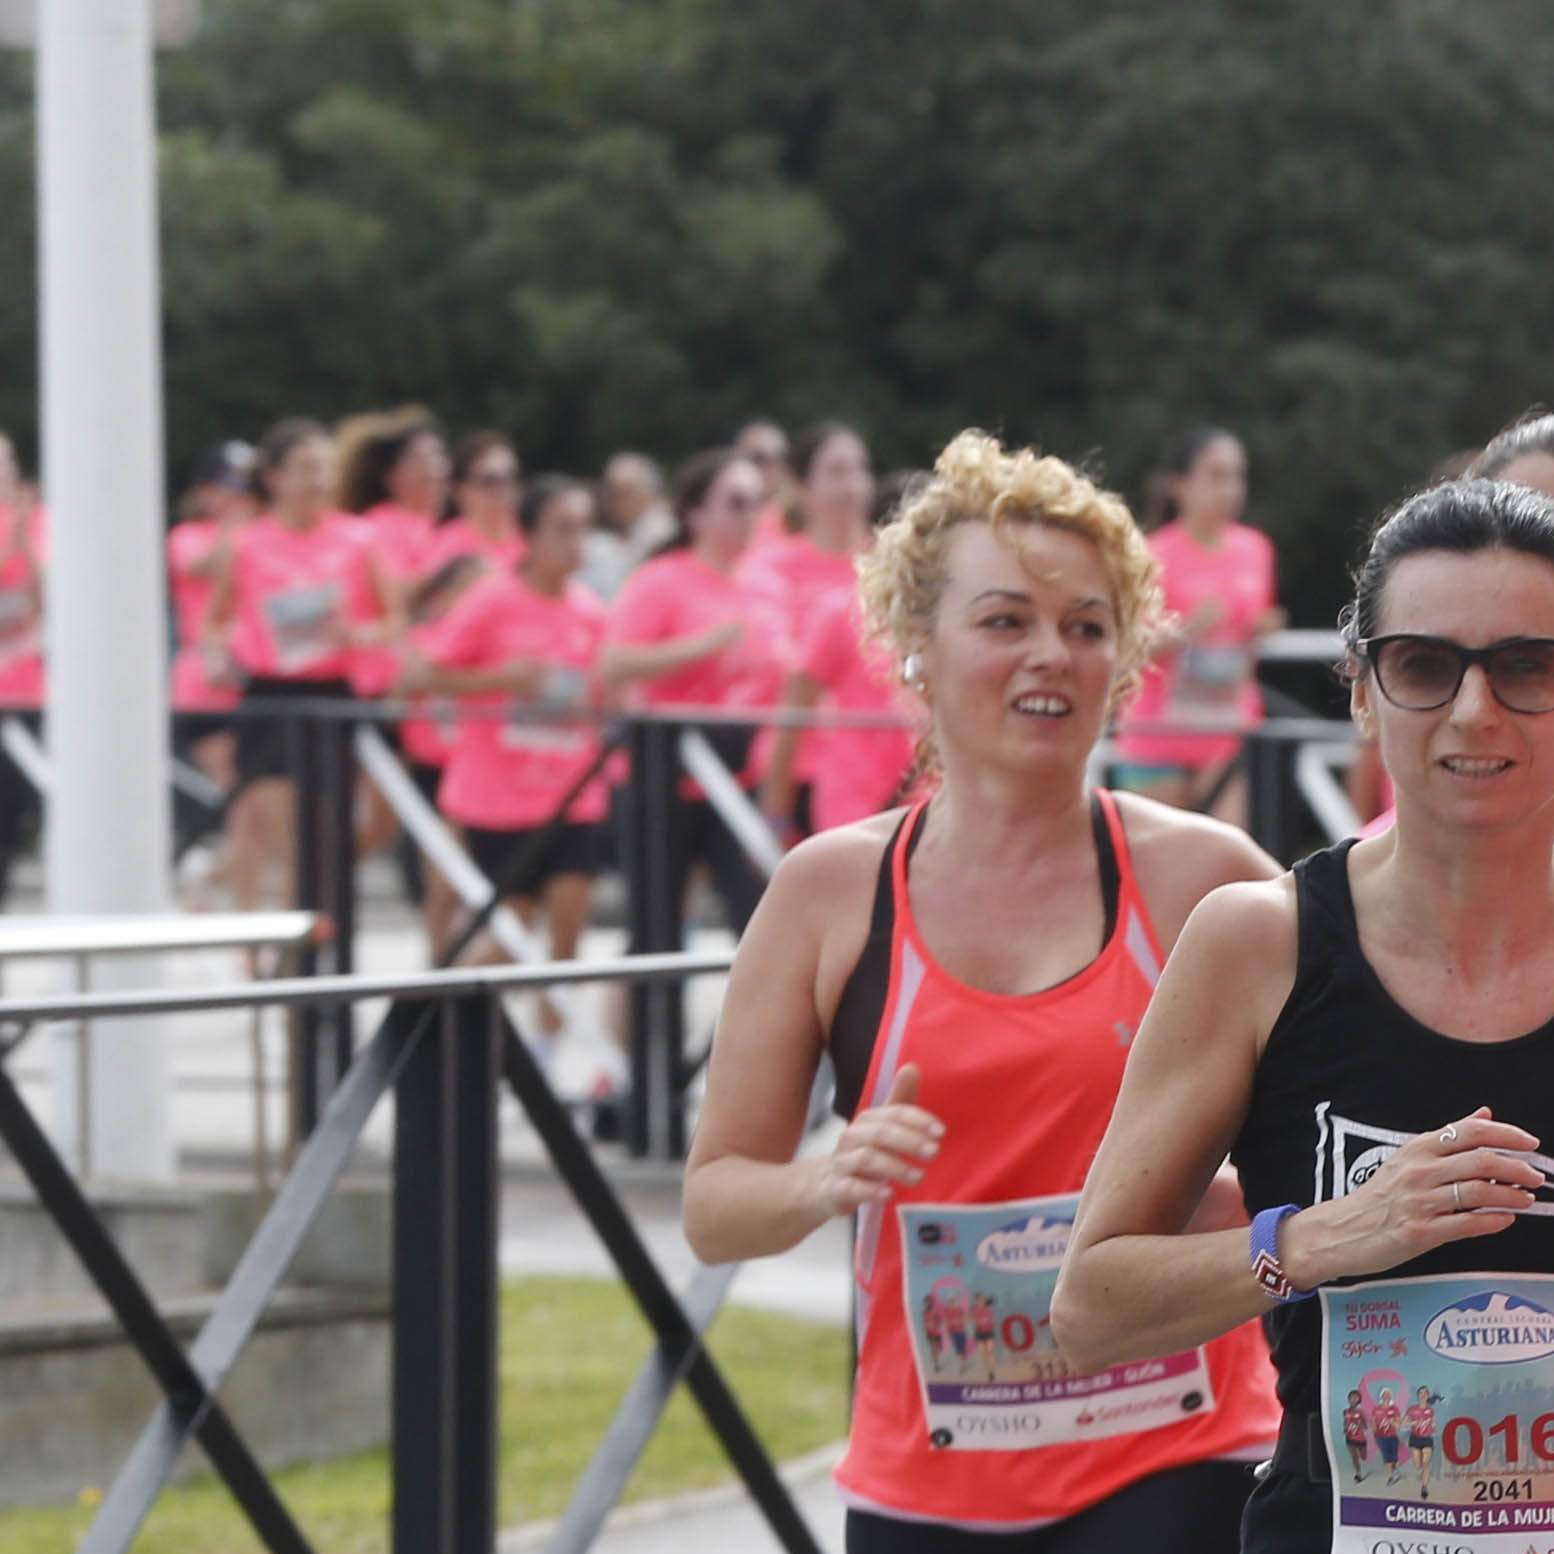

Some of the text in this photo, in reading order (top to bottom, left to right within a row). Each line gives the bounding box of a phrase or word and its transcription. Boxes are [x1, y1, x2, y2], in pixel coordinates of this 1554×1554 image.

[983, 1242, 1067, 1264] ASTURIA
[1345, 1312, 1401, 1332] SUMA
[956, 1413, 1041, 1435] OYSHO
[1473, 1478, 1533, 1502] 2041
[1384, 1504, 1456, 1527] CARRERA
[1460, 1508, 1484, 1529] DE
[1487, 1507, 1510, 1527] LA
